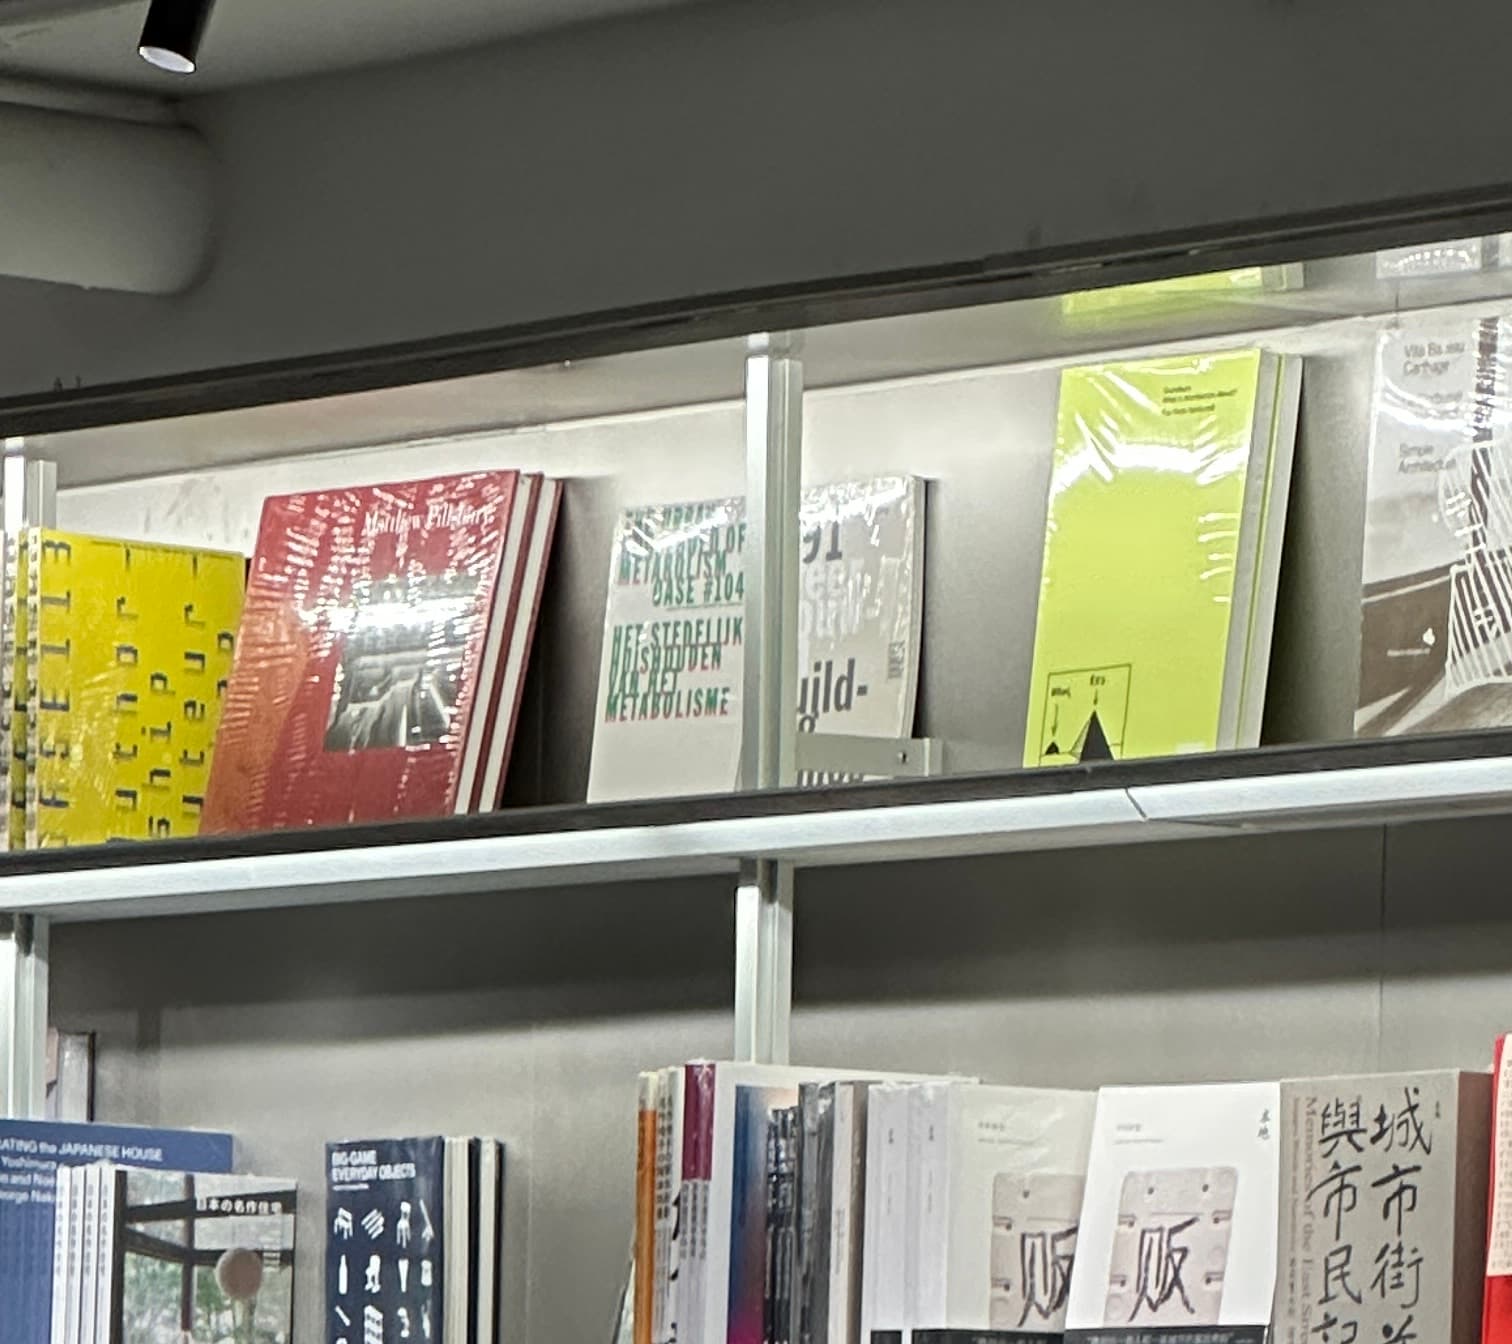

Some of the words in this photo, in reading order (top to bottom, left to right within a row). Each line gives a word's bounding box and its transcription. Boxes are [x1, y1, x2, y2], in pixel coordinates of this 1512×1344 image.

[604, 687, 731, 723] METABOLISME
[59, 1142, 120, 1159] JAPANESE
[121, 1145, 163, 1162] HOUSE
